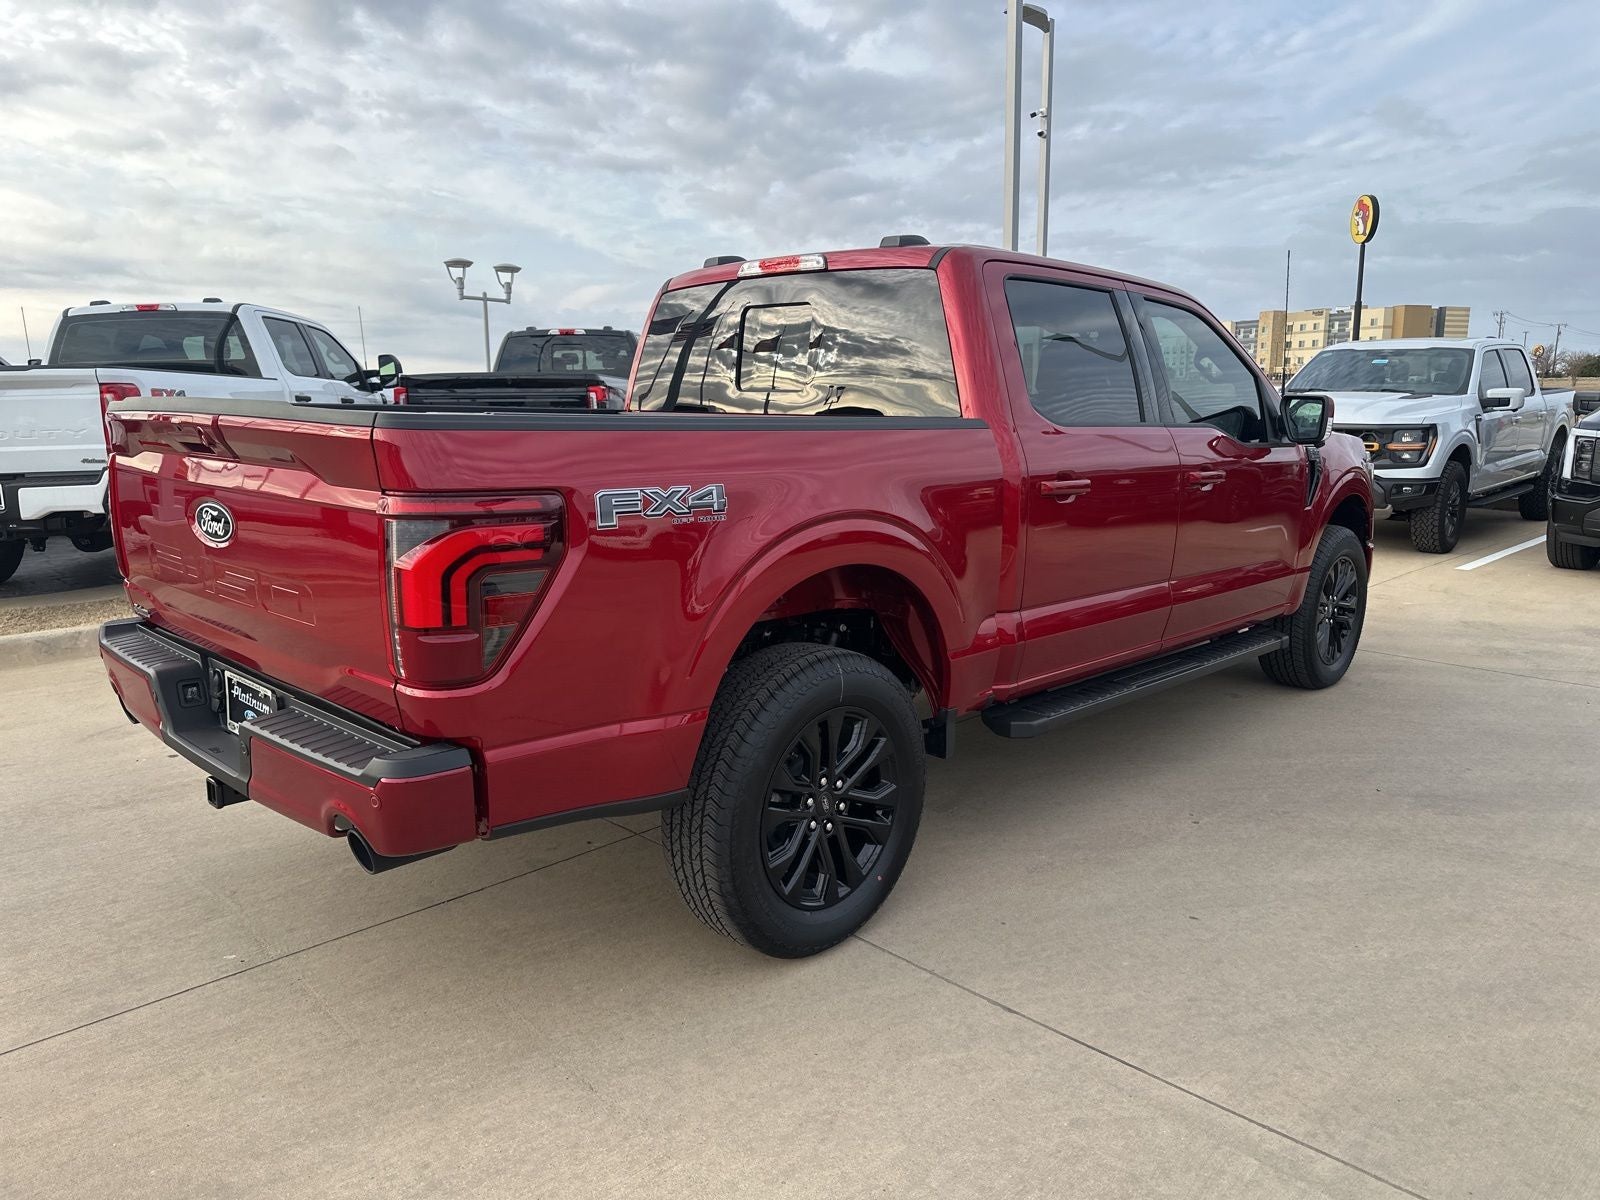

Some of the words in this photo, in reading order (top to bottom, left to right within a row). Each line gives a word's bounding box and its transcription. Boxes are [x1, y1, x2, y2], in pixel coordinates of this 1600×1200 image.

[201, 507, 225, 536] Ford
[594, 484, 727, 530] FX4
[231, 685, 270, 715] Platinum
